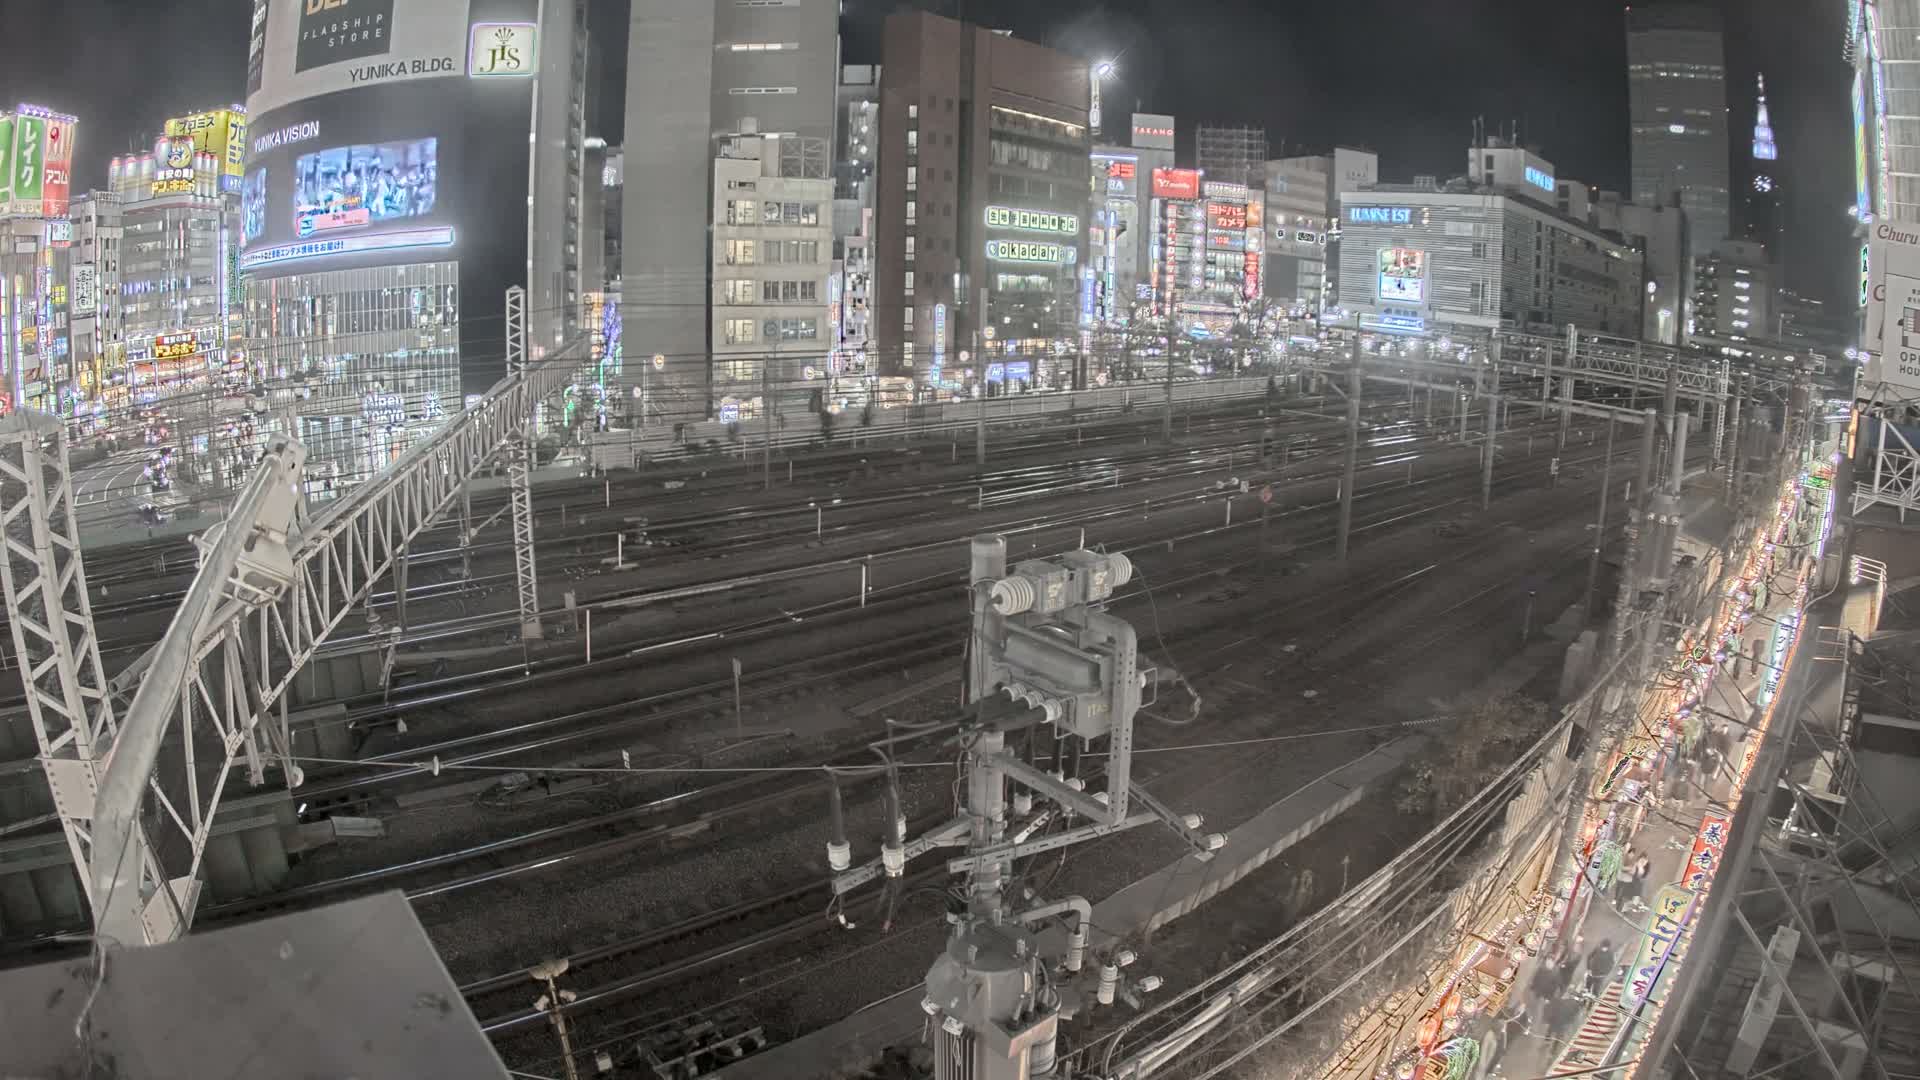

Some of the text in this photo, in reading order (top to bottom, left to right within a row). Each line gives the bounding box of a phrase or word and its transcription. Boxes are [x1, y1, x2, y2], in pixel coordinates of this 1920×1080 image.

[303, 13, 383, 41] FLAGSHIP
[328, 27, 382, 48] STORE
[349, 57, 456, 82] YUNIKA BLDG.
[254, 120, 320, 152] YUNIKA VISION
[1133, 126, 1175, 136] TAKANO
[22, 121, 37, 188] レイク
[45, 168, 68, 185] アコム
